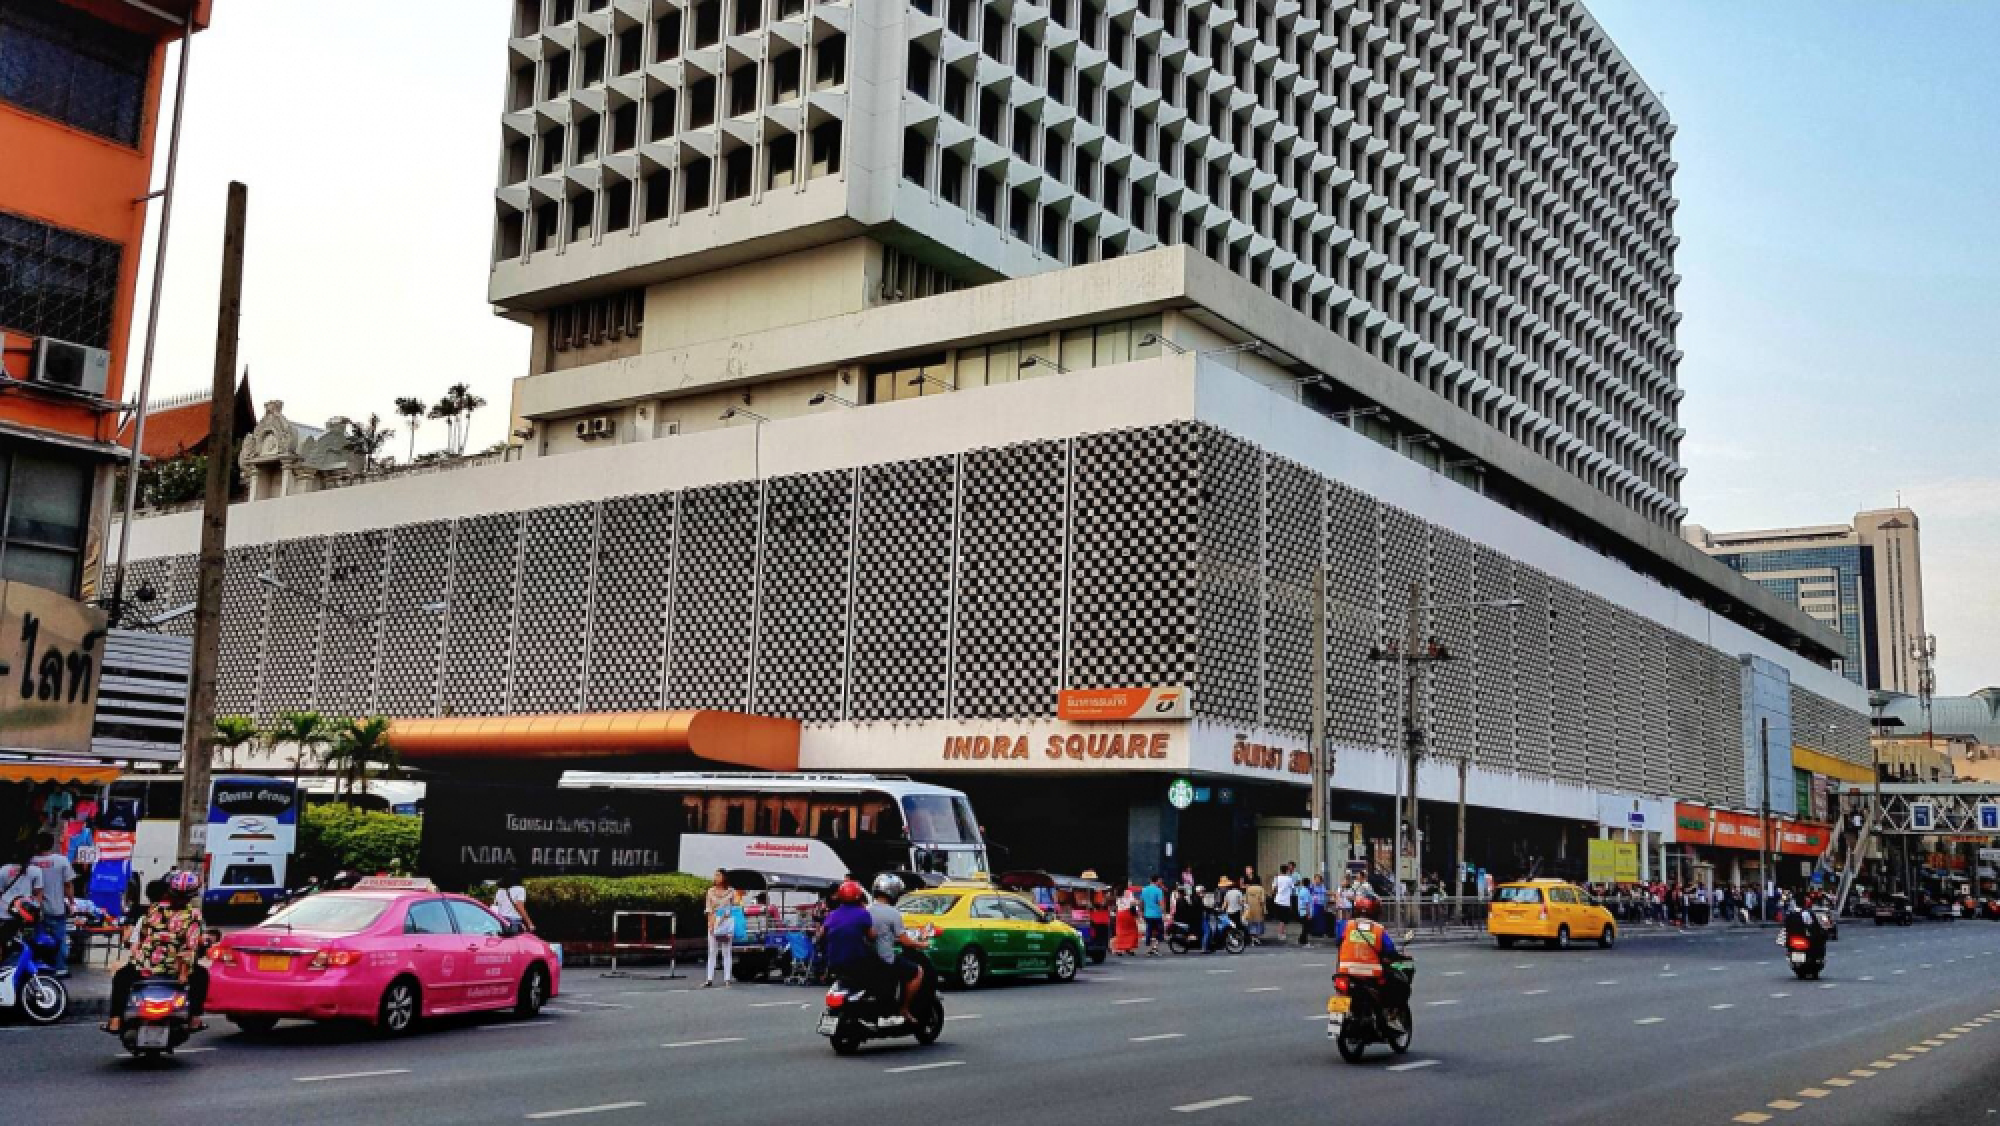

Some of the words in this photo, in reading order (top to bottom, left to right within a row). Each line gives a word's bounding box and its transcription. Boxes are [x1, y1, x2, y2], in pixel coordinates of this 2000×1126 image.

[942, 735, 1030, 760] INDRA
[1046, 733, 1170, 760] SQUARE
[460, 845, 517, 865] INDRA
[531, 846, 601, 866] REGENT
[610, 847, 664, 867] HOTEL
